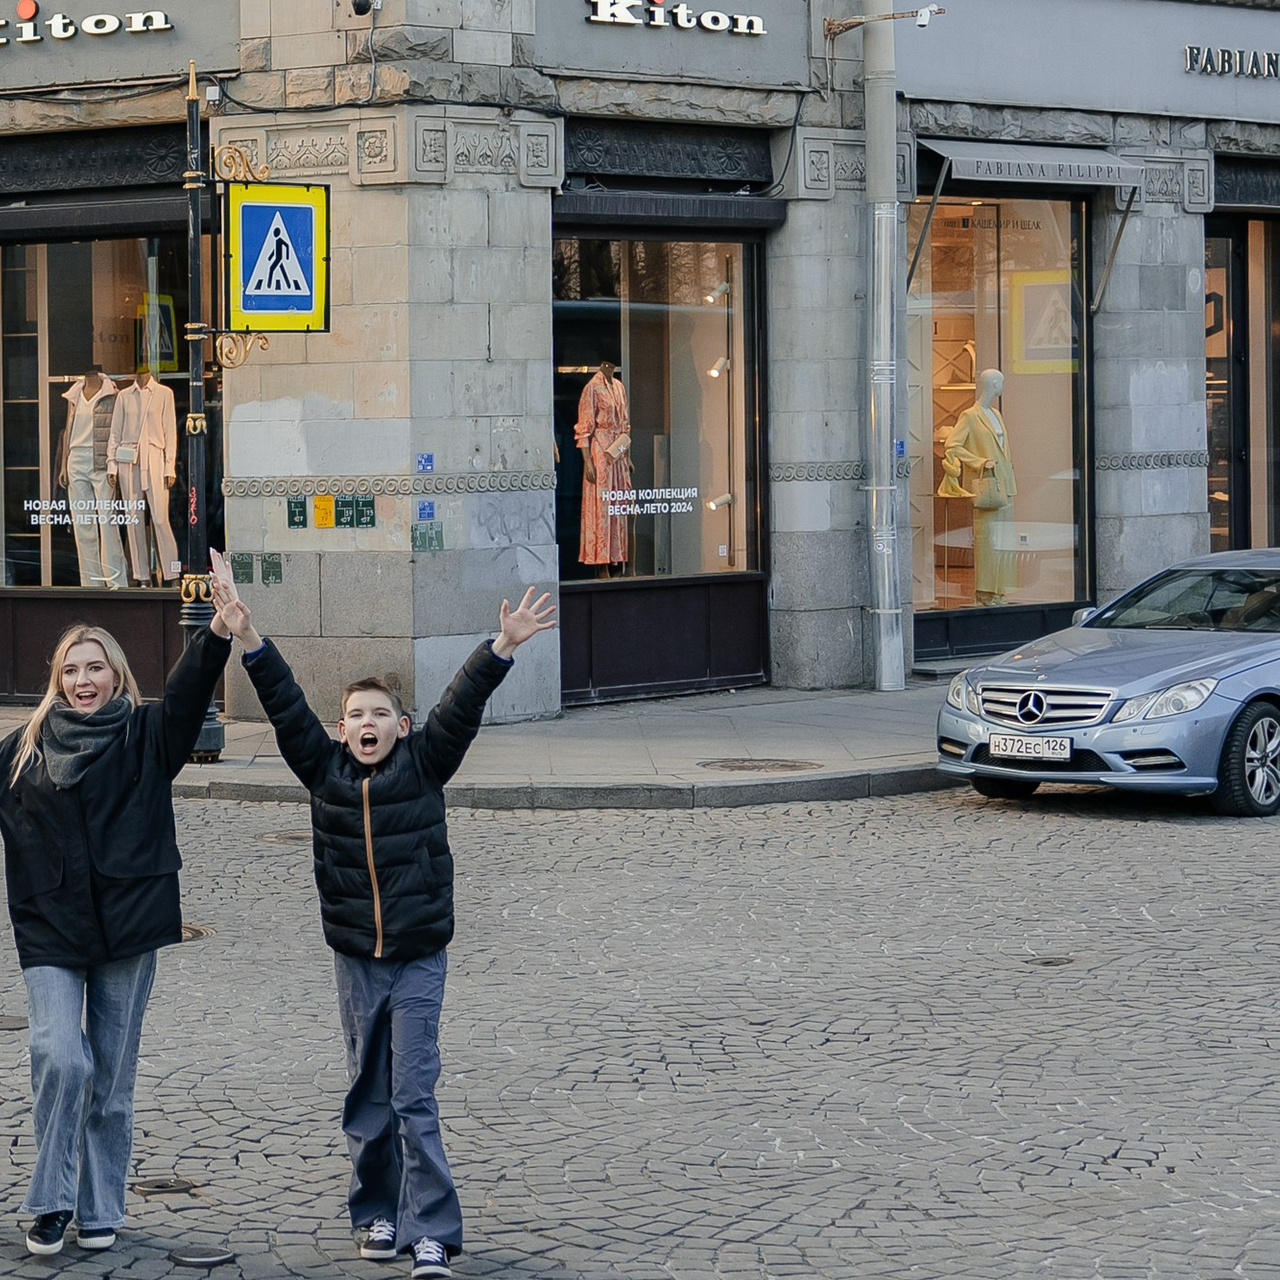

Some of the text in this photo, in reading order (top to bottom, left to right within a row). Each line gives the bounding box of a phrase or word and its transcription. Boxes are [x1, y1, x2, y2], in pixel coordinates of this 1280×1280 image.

[975, 160, 1120, 179] FABIANA FILIPPI
[602, 487, 698, 501] НОВАЯ КОЛЛЕКЦИЯ
[23, 499, 146, 511] НОВАЯ КОЛЛЕКЦИЯ
[608, 502, 693, 516] ВЕСНА-ЛЕТО 2024
[30, 514, 140, 525] ВЕСНА-ЛЕТО 2024
[1045, 740, 1066, 751] 126
